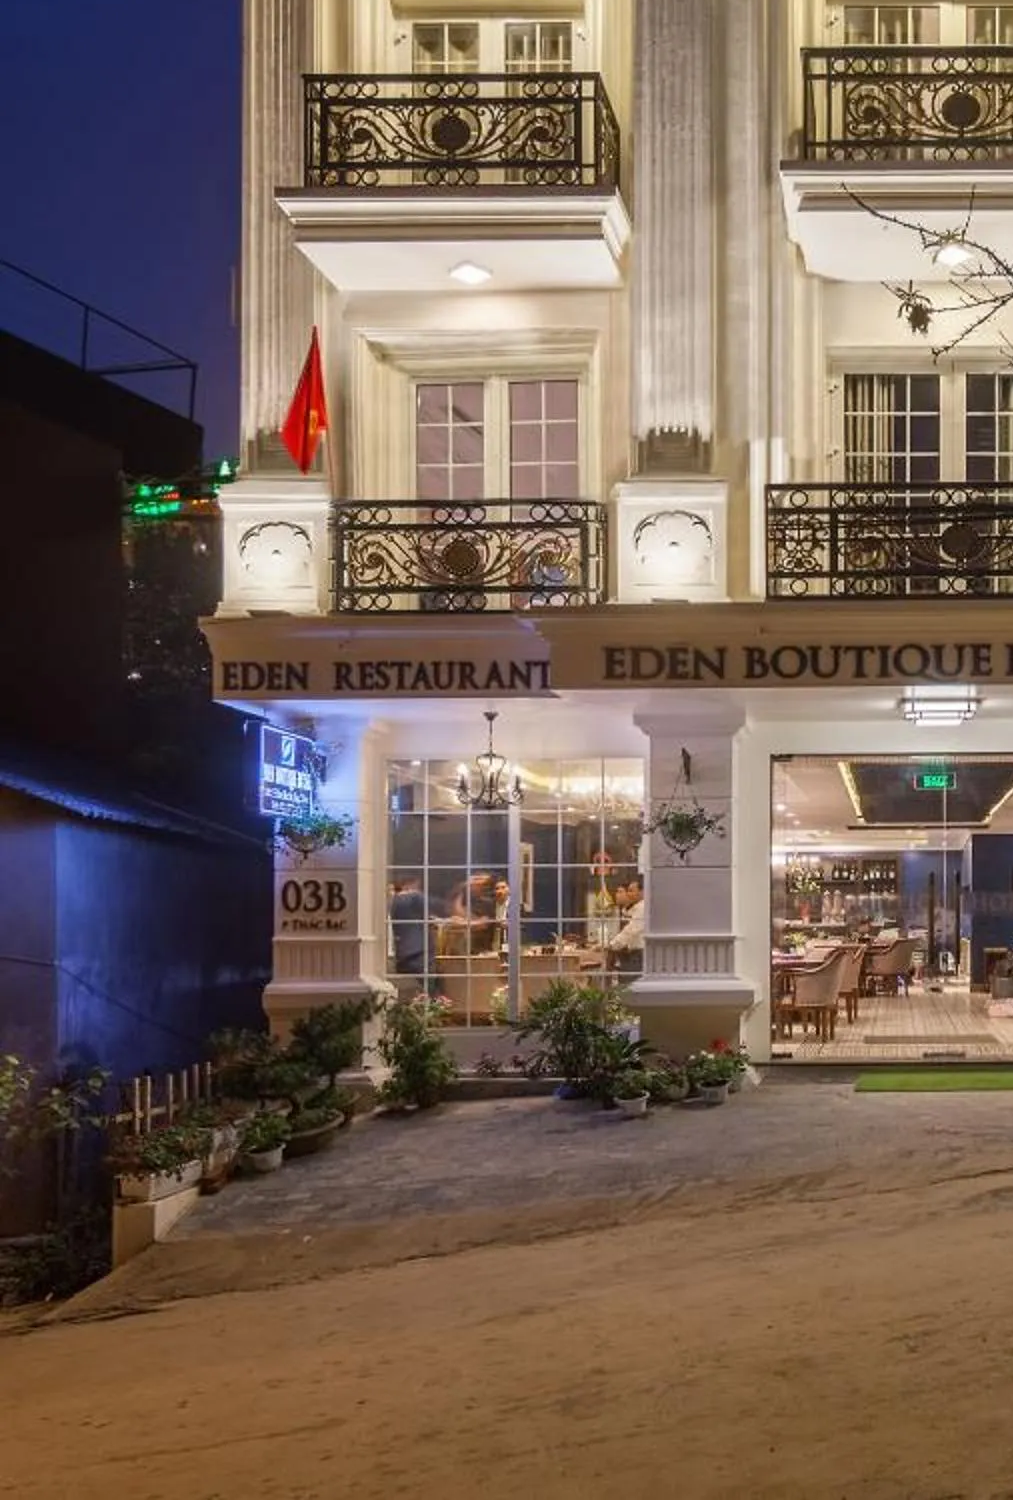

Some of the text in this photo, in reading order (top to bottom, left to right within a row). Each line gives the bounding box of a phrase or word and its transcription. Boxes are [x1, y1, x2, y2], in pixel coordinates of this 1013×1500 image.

[221, 660, 551, 692] EDEN RESTAURANT
[602, 645, 728, 681] EDEN
[742, 642, 993, 681] BOUTIQUE
[280, 879, 347, 914] 03B
